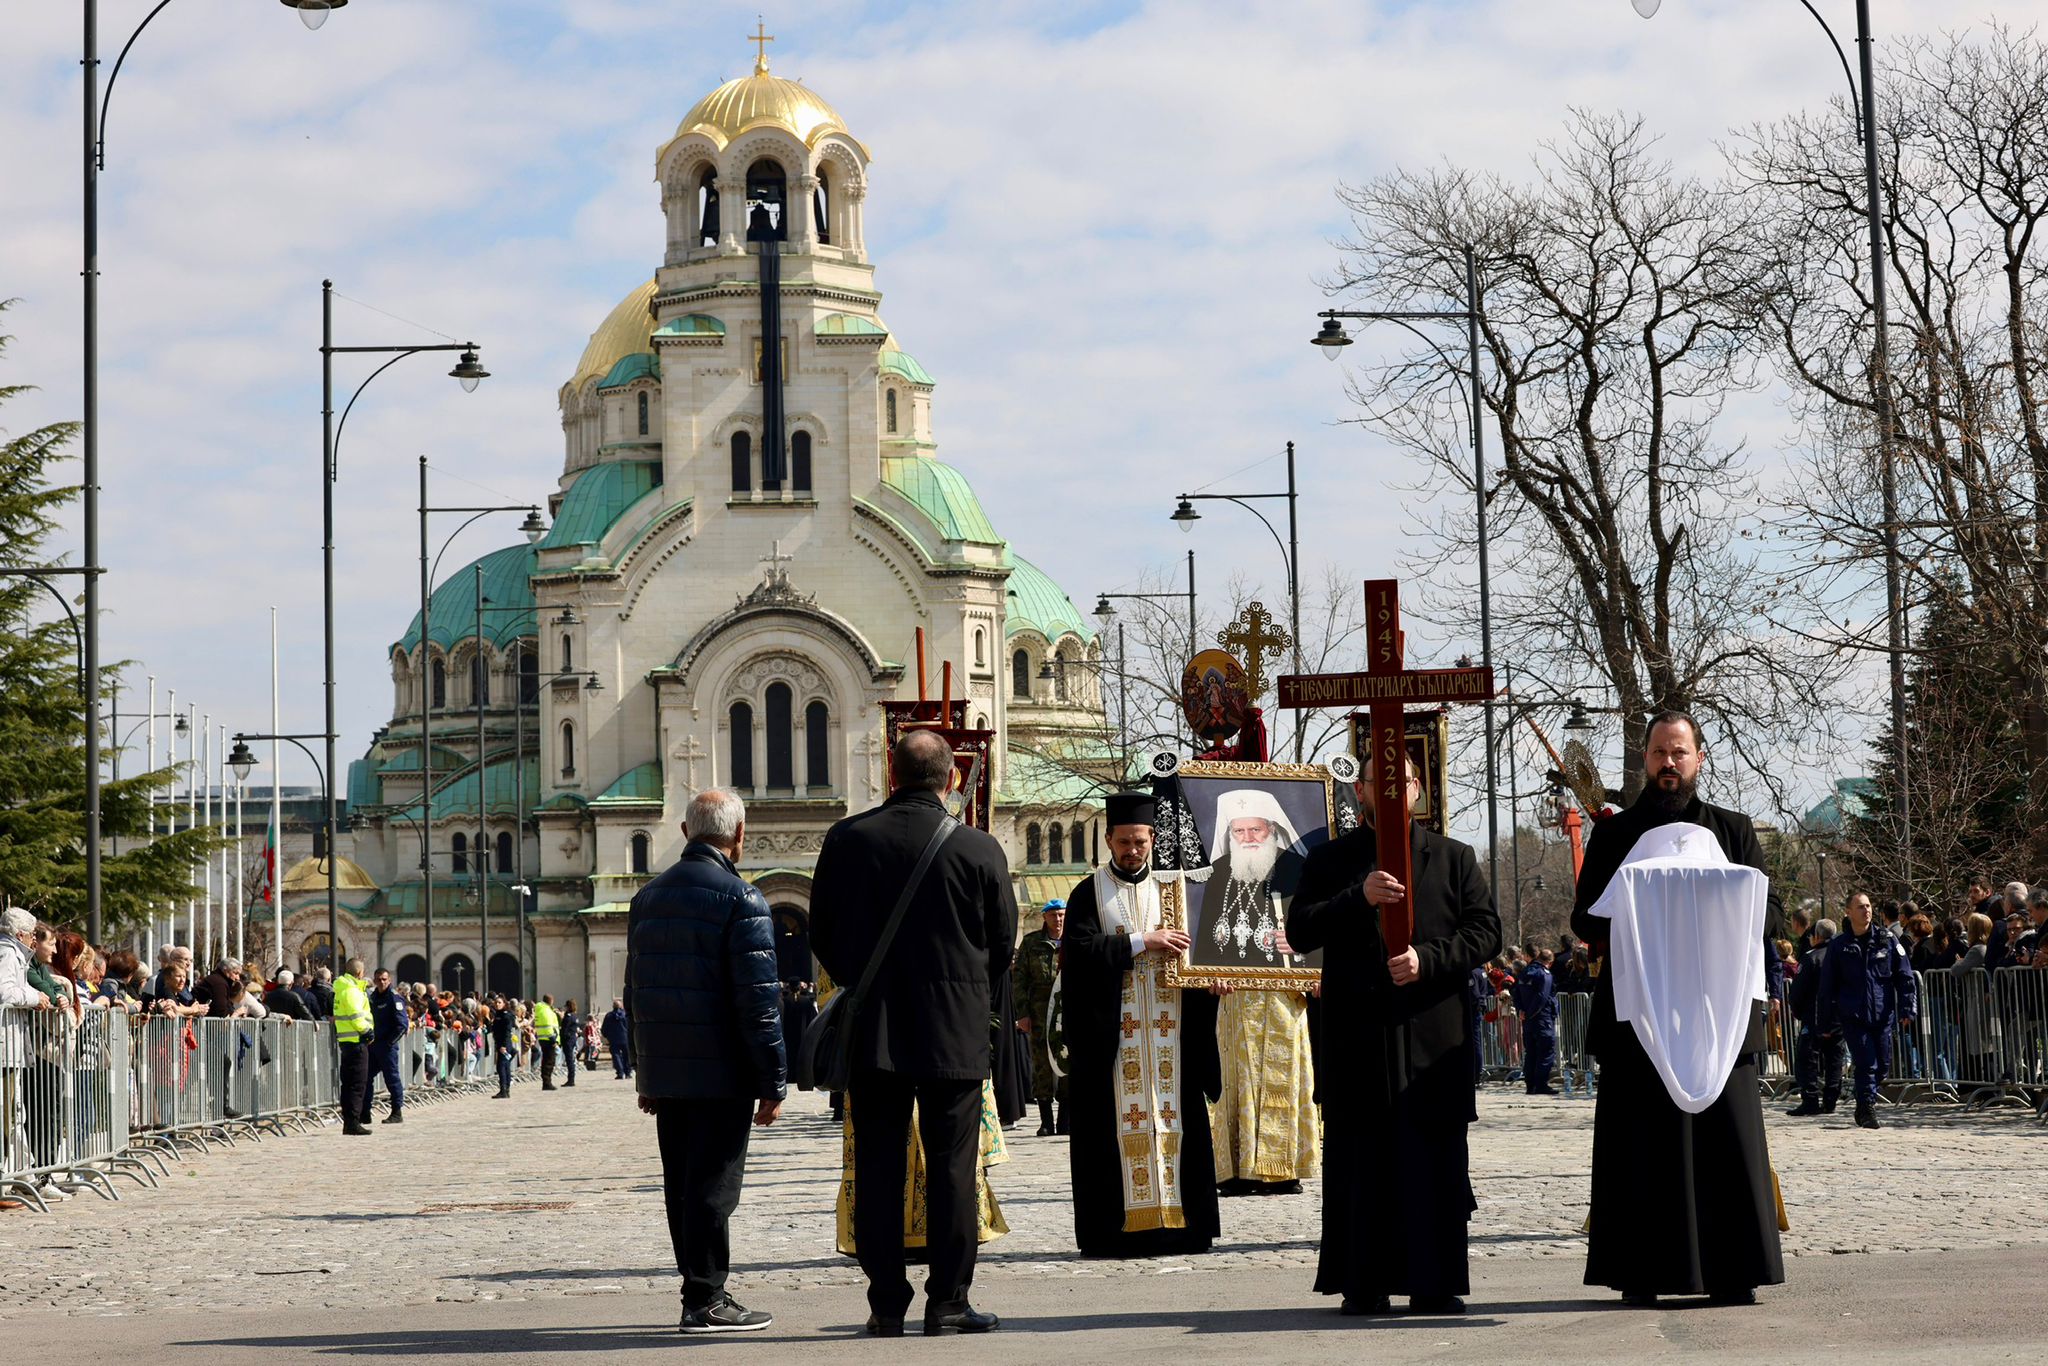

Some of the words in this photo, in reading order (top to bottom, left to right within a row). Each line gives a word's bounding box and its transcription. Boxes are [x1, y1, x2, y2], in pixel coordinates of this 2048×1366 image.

[1378, 590, 1392, 664] 1945
[1353, 675, 1414, 699] ПАТРИАРХ
[1418, 672, 1485, 696] БЪЛГАРСКИ
[1384, 727, 1398, 800] 2024
